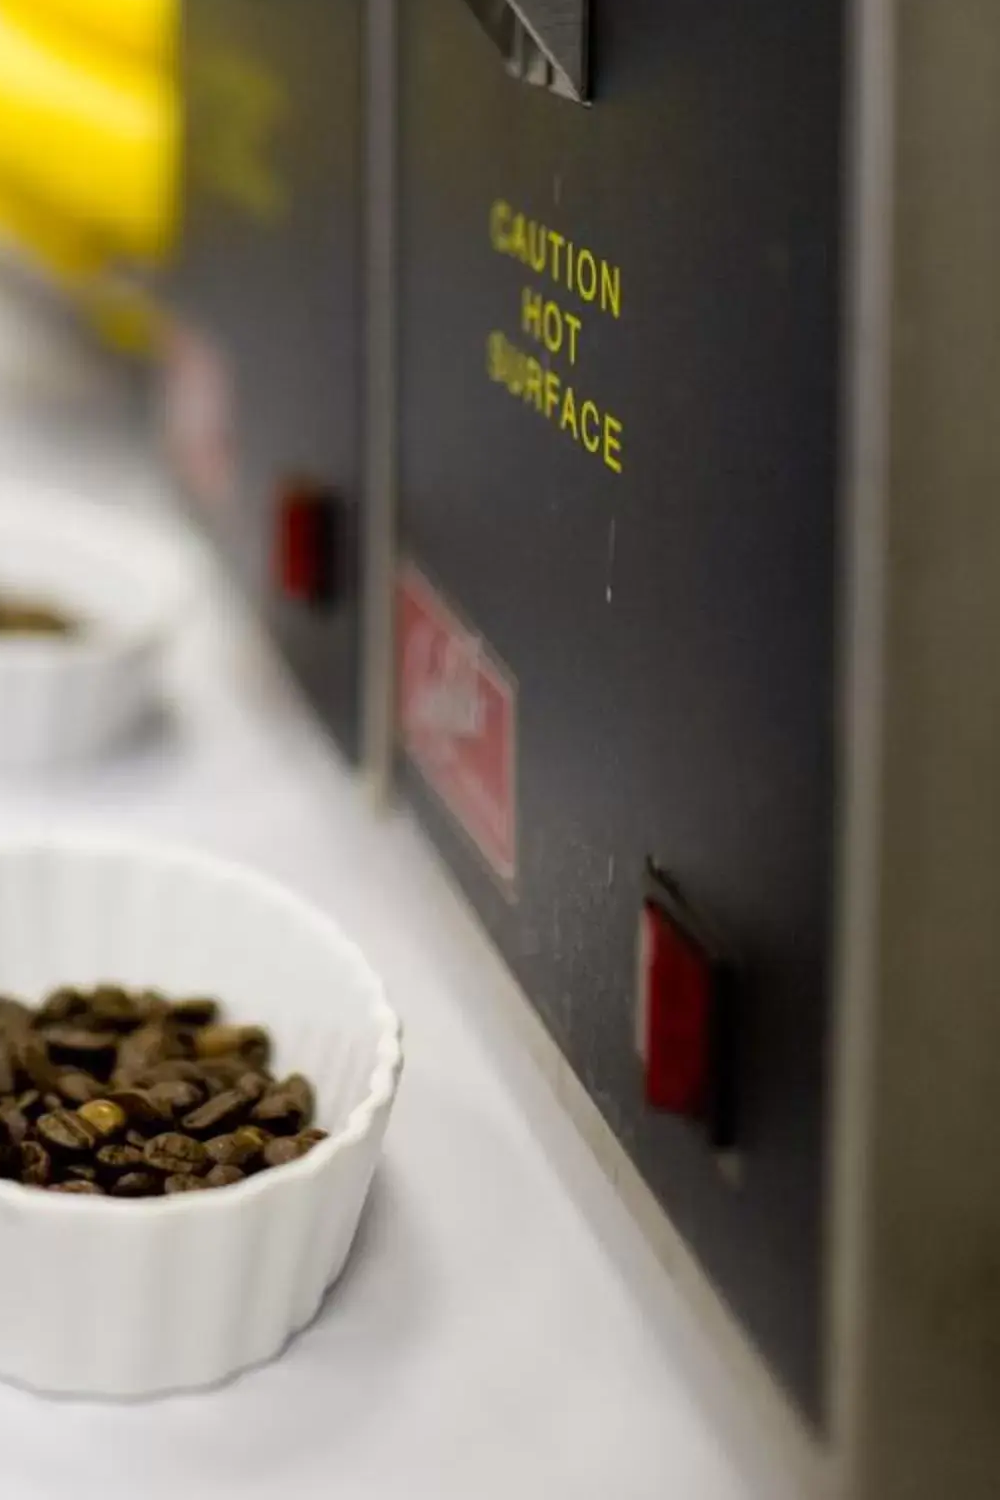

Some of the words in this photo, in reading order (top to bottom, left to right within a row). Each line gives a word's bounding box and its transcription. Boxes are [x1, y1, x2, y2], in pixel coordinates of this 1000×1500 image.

[489, 199, 621, 318] CAUTION
[521, 286, 582, 366] HOT
[487, 331, 622, 474] SURFACE
